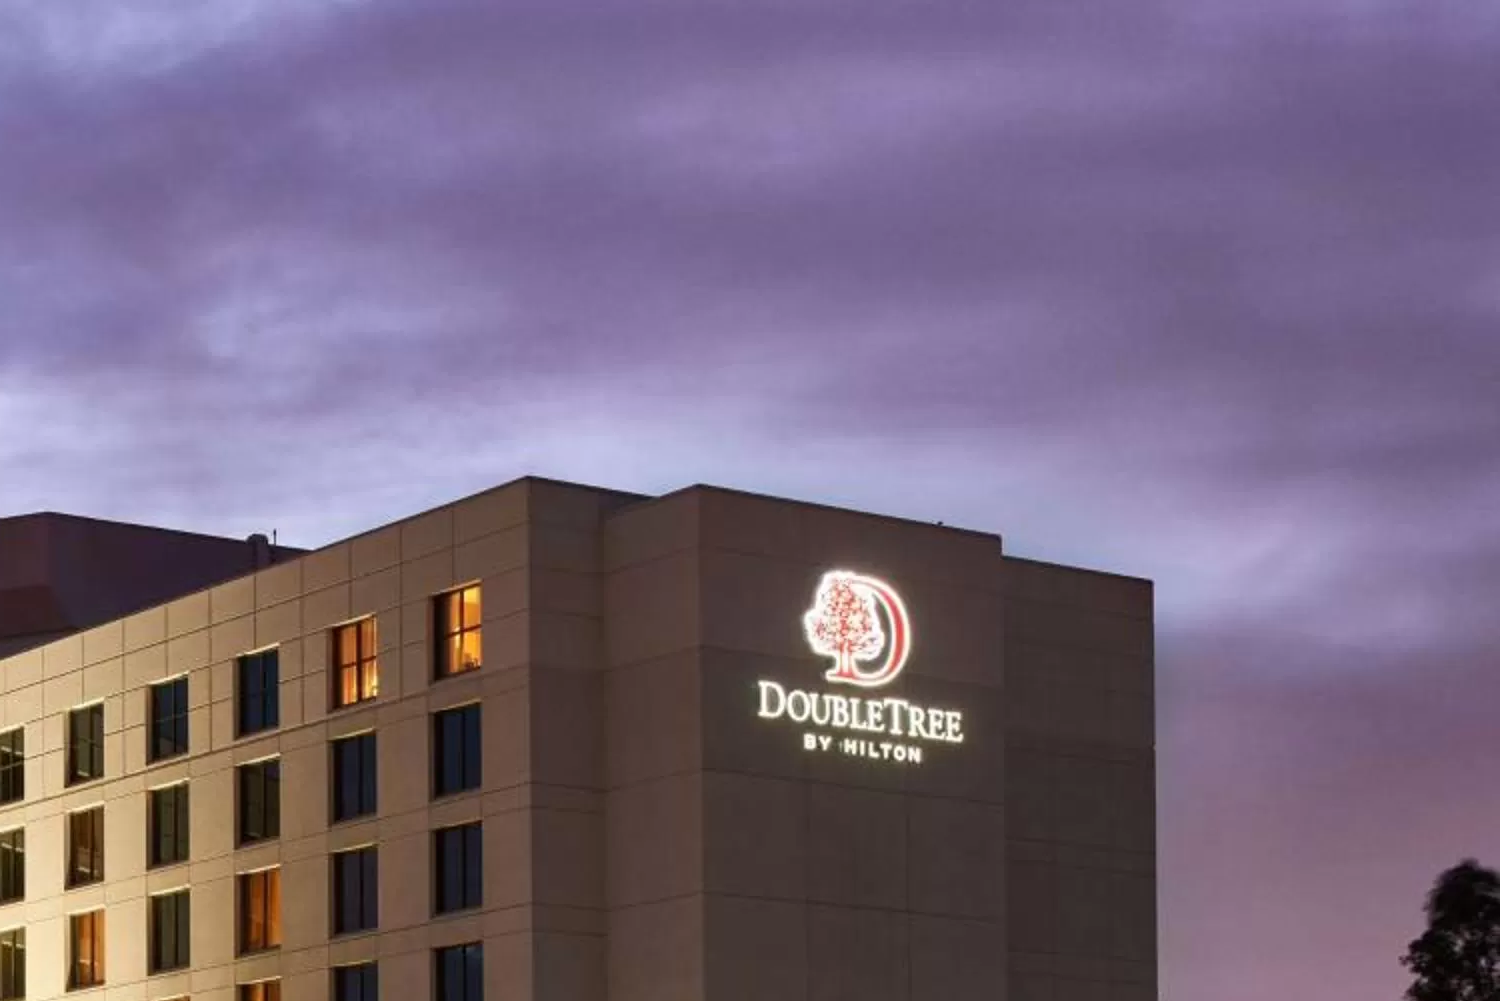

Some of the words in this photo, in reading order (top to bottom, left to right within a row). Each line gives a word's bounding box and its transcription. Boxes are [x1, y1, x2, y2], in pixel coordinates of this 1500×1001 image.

[757, 679, 964, 743] DOUBLETREE
[803, 733, 832, 751] BY
[843, 738, 922, 764] HILTON
